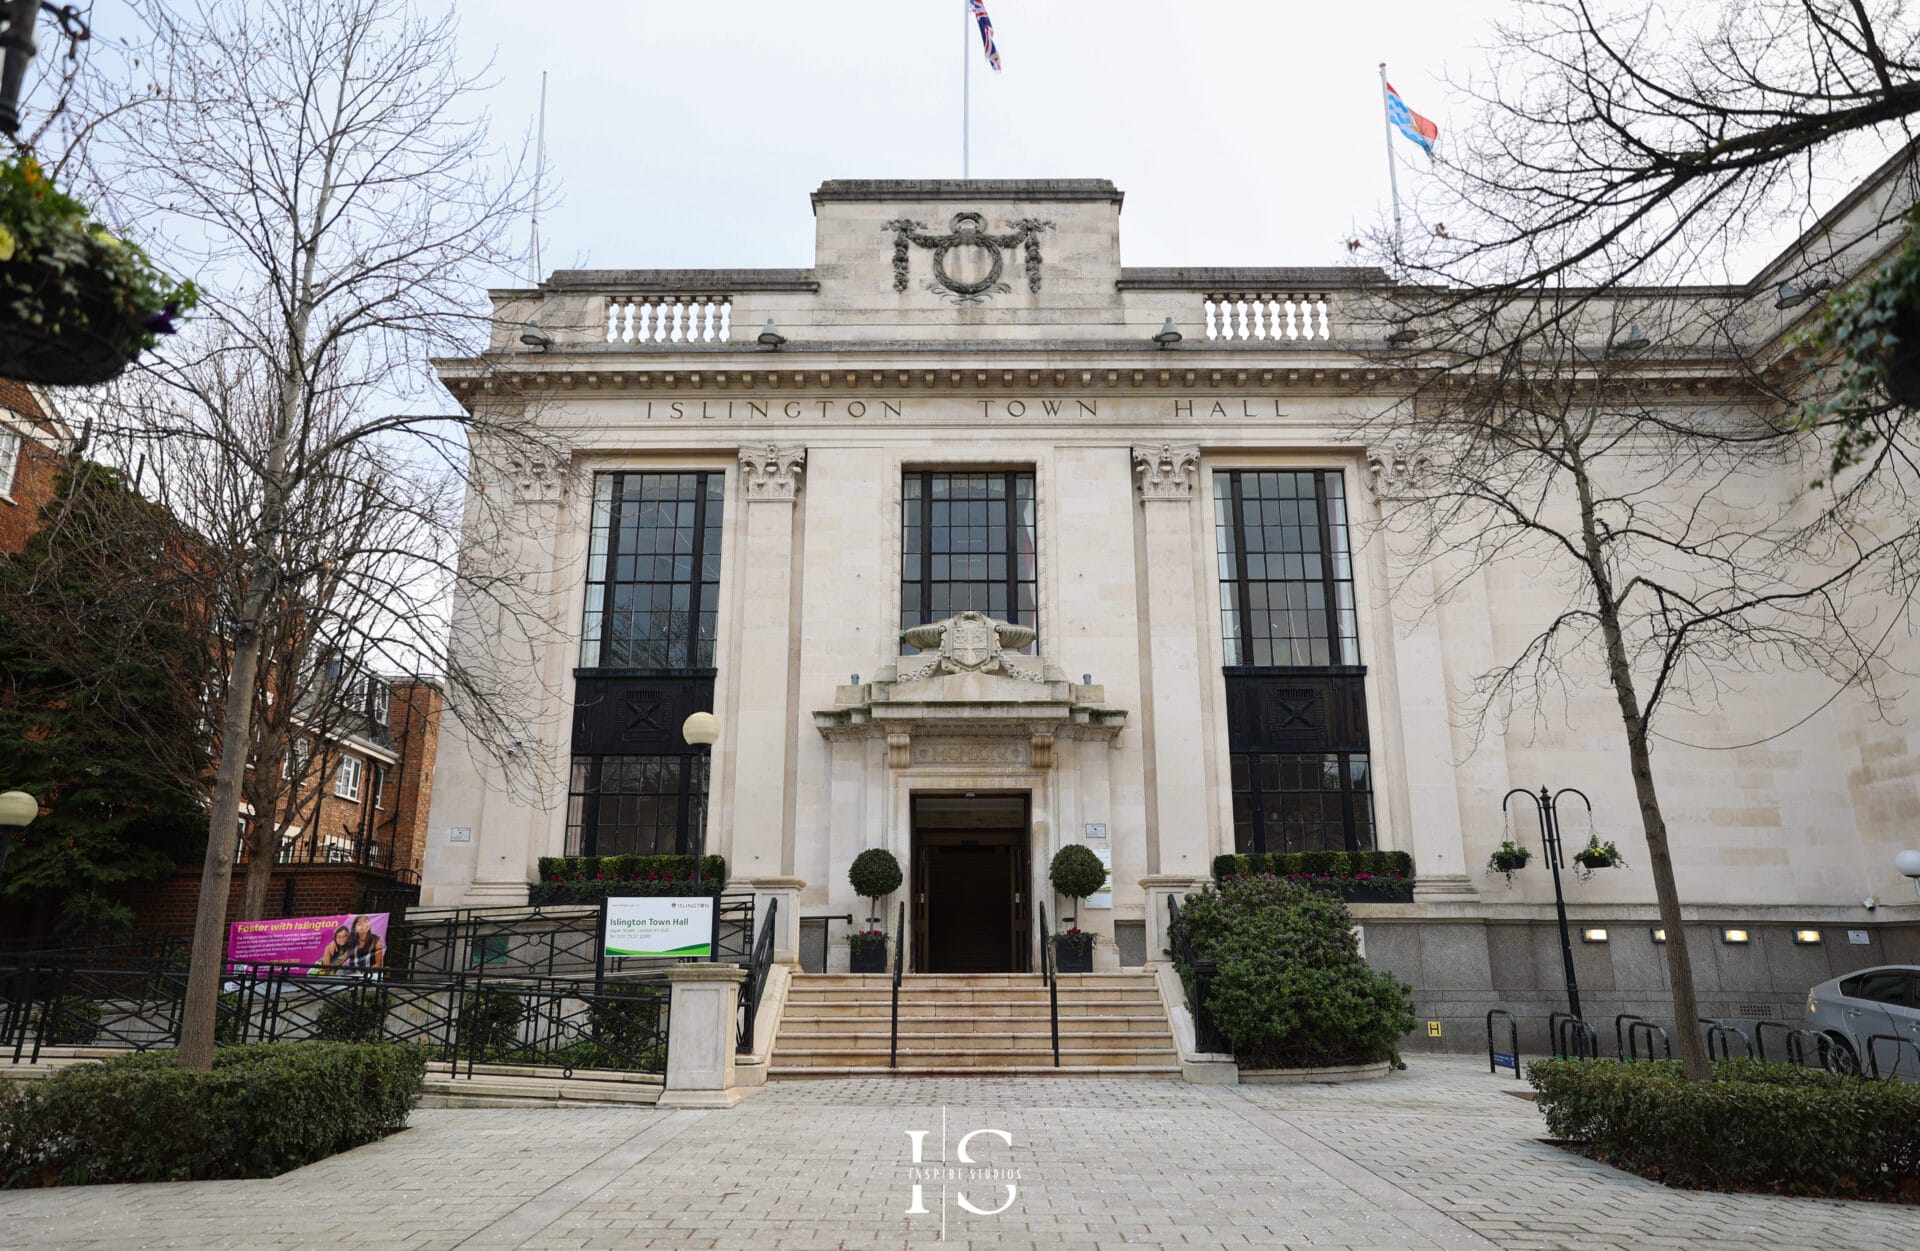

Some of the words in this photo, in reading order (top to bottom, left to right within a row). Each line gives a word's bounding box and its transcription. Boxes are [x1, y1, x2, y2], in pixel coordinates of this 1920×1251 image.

[647, 400, 902, 419] ISLINGTON
[976, 400, 1097, 418] TOWN
[1174, 399, 1290, 418] HALL
[237, 924, 269, 933] Foster
[271, 922, 293, 931] with
[294, 920, 339, 931] Islington
[610, 918, 646, 928] Islington
[649, 918, 671, 926] Town
[672, 918, 689, 926] Hall
[1429, 1022, 1440, 1035] H
